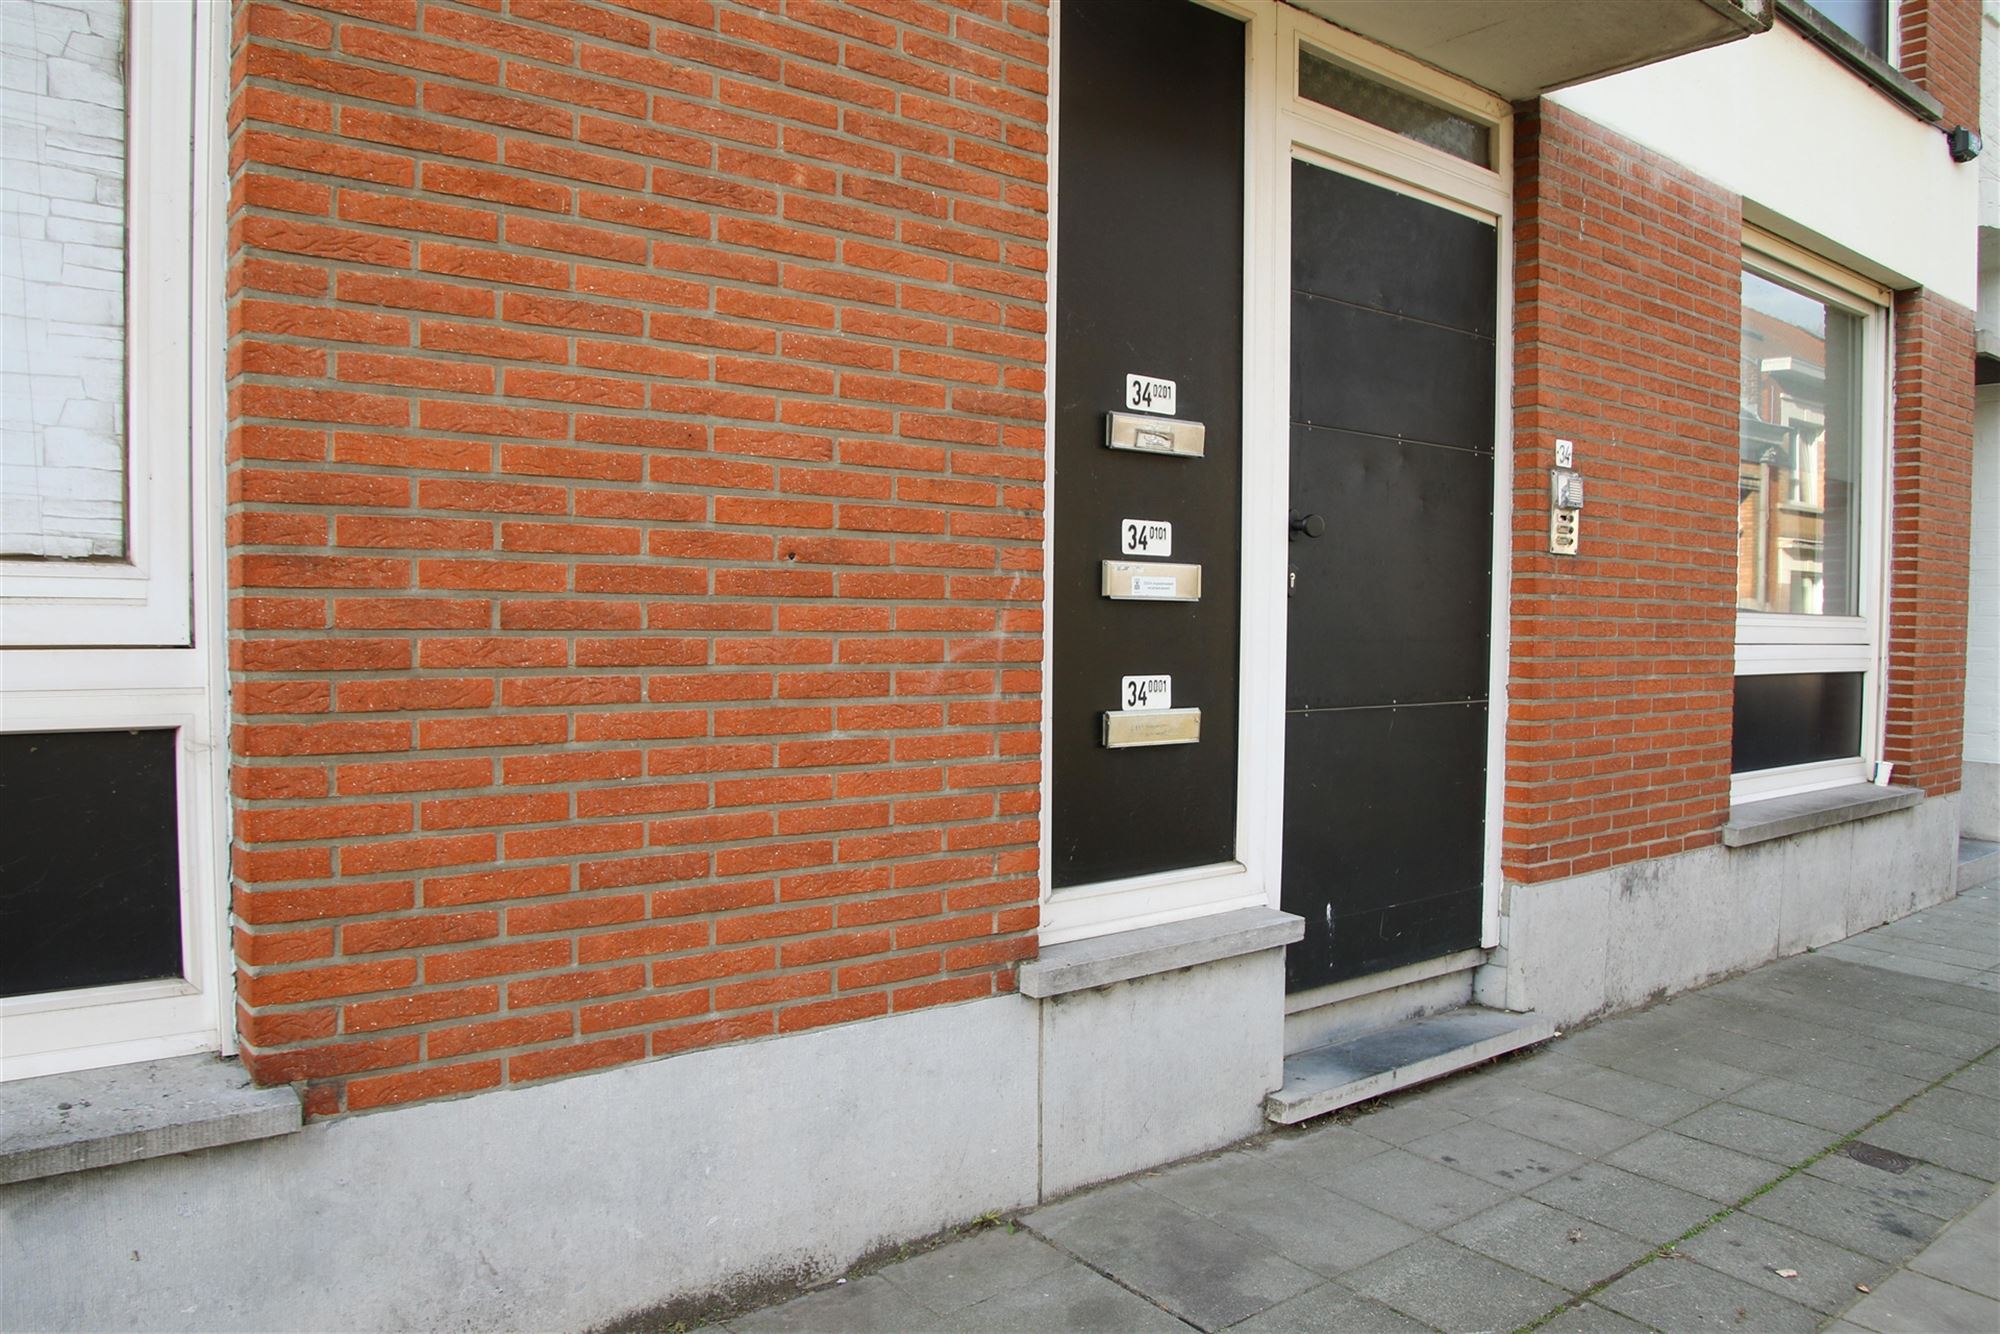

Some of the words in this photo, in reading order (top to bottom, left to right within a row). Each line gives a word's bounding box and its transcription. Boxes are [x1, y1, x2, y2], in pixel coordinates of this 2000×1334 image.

[1132, 380, 1152, 407] 34
[1153, 384, 1171, 399] 0201
[1559, 444, 1571, 465] 34
[1128, 524, 1148, 550] 34
[1149, 526, 1167, 540] 0101
[1128, 680, 1148, 706] 34
[1148, 679, 1167, 693] 0001
